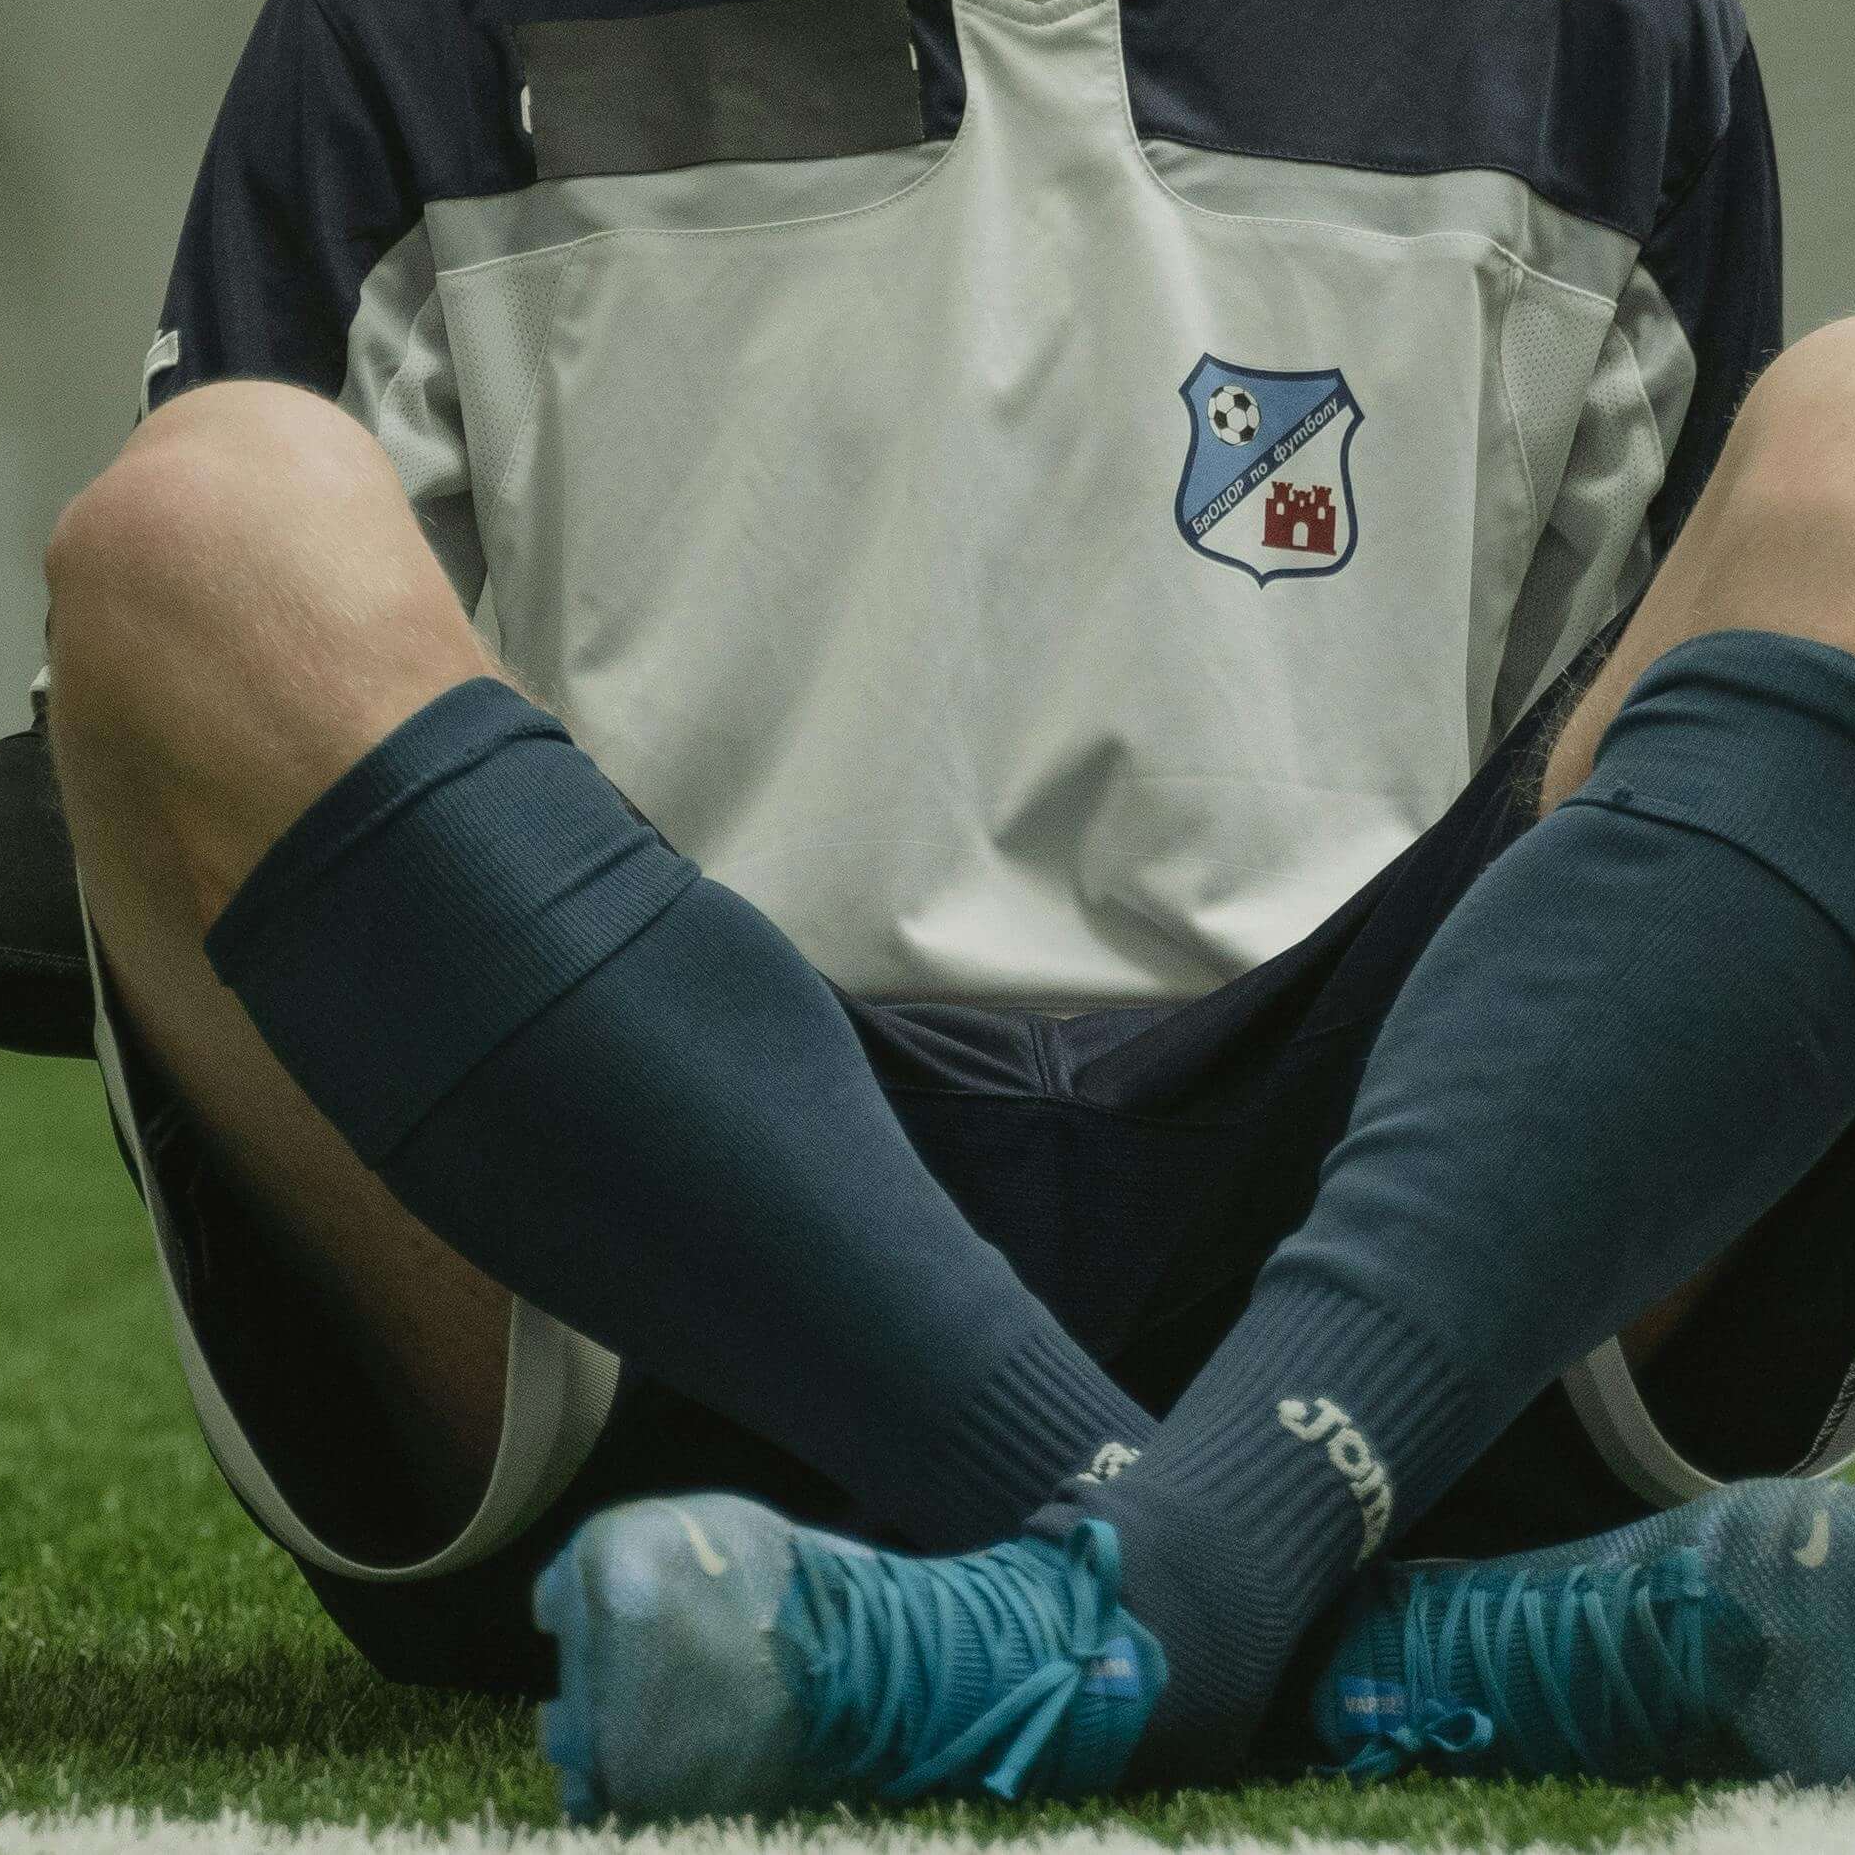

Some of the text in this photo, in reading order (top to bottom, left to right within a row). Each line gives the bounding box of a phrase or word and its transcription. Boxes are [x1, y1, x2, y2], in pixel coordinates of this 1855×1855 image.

[1191, 398, 1339, 535] БрОЦОР по футболу
